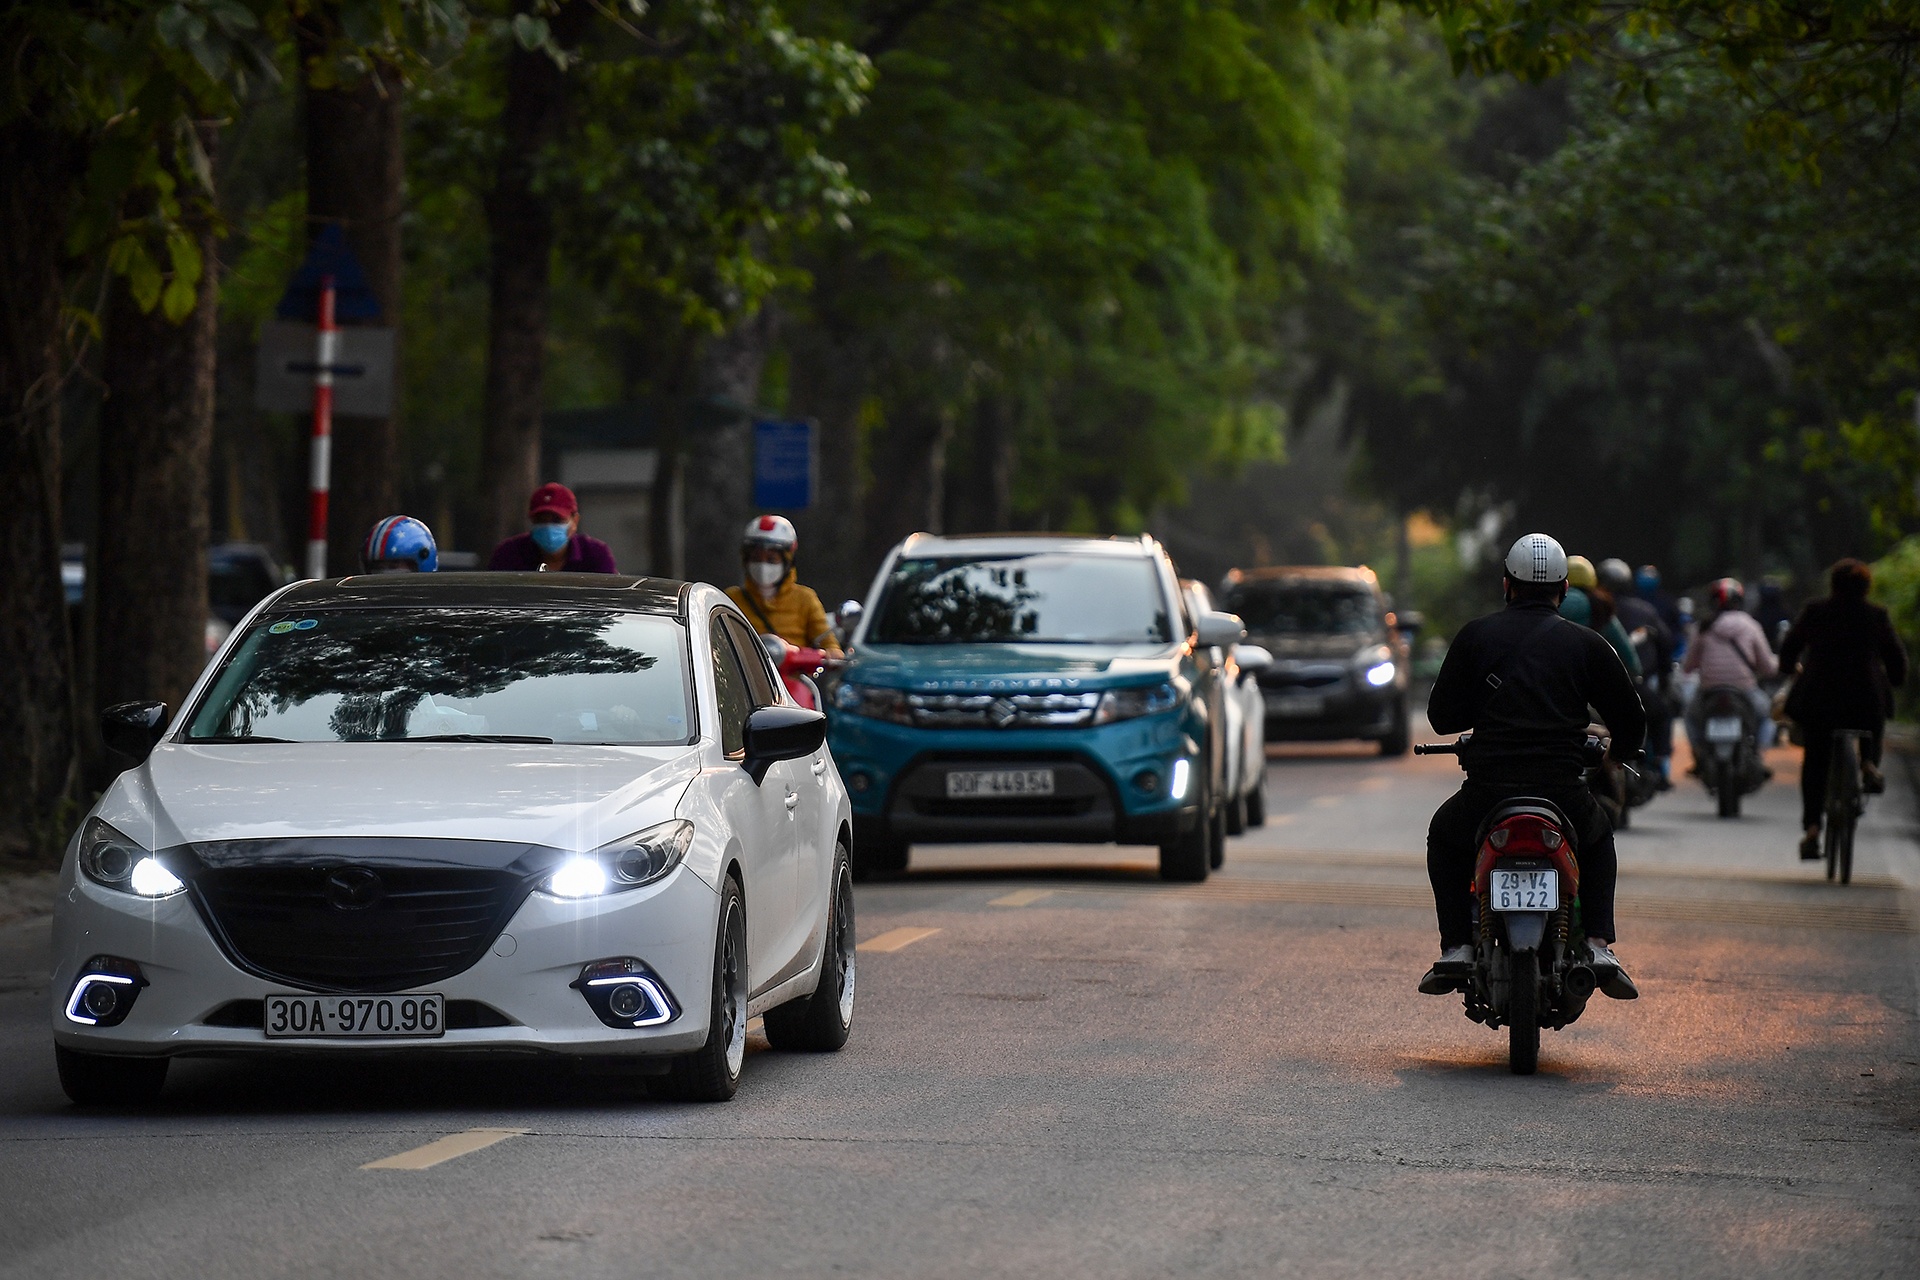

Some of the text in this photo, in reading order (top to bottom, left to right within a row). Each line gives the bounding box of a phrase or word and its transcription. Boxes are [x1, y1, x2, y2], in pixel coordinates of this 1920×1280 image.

[1501, 873, 1548, 890] 29-V4
[1501, 891, 1548, 908] 6122
[271, 999, 438, 1032] 30A-970.96
